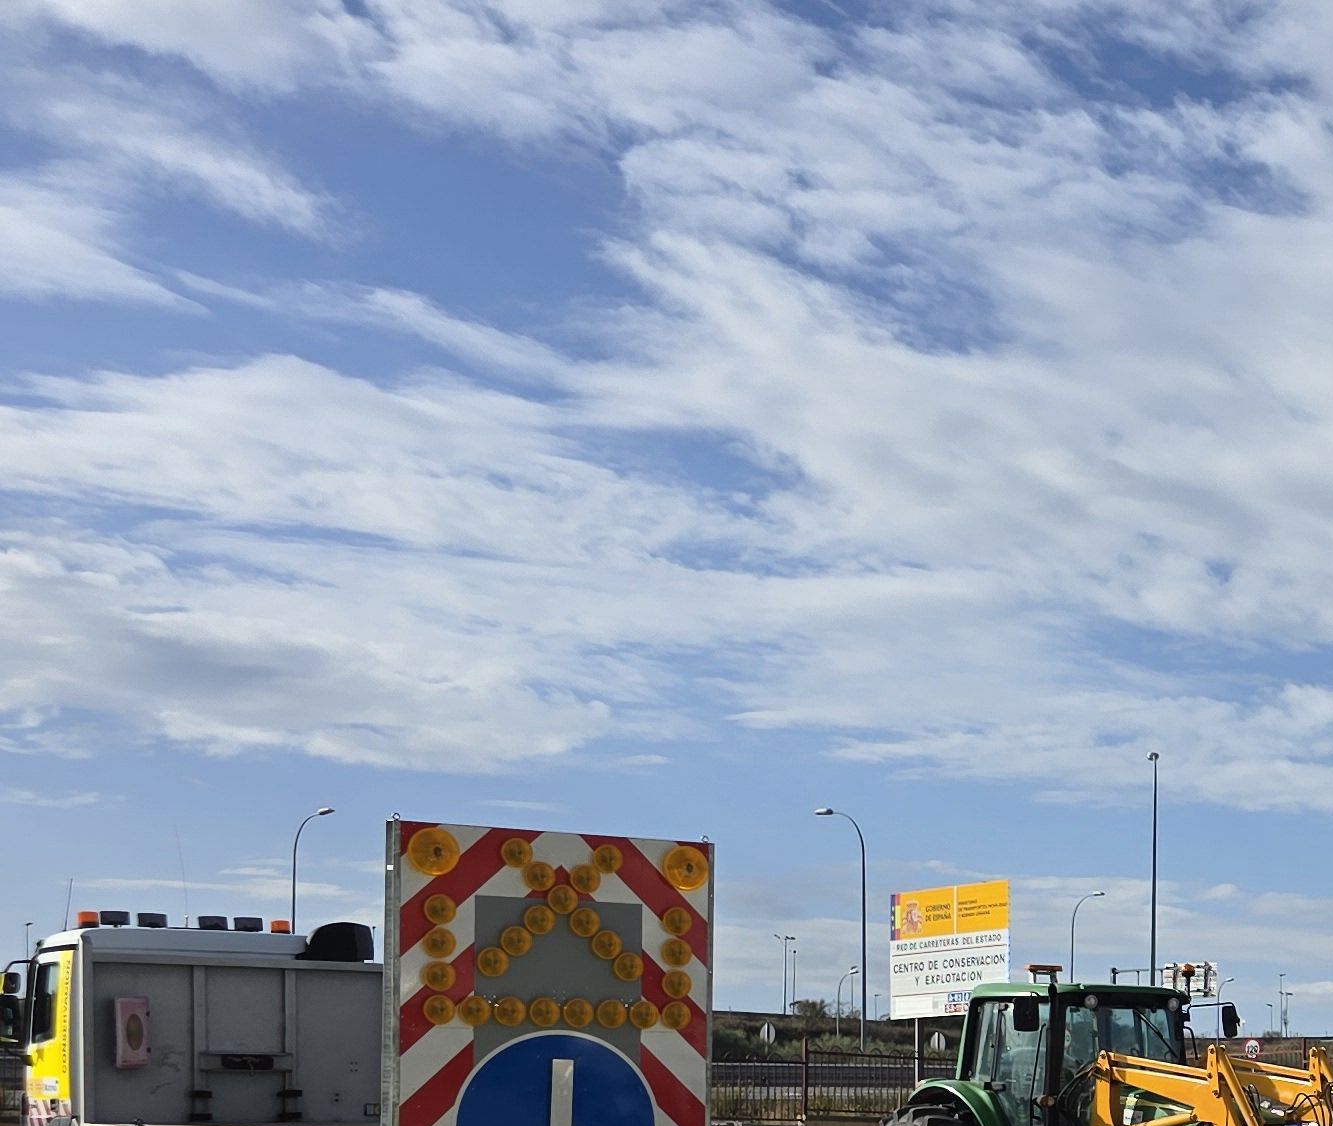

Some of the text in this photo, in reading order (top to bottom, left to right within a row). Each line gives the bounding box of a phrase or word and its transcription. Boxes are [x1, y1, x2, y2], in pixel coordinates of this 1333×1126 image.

[925, 903, 951, 913] GOBIERNO
[925, 914, 932, 922] DE
[933, 910, 951, 921] ESPAÑA
[896, 933, 1002, 951] RED DE CARRETERAS DEL ESTADO
[893, 961, 925, 974] CENTRO
[928, 960, 938, 970] DE
[914, 976, 921, 986] Y
